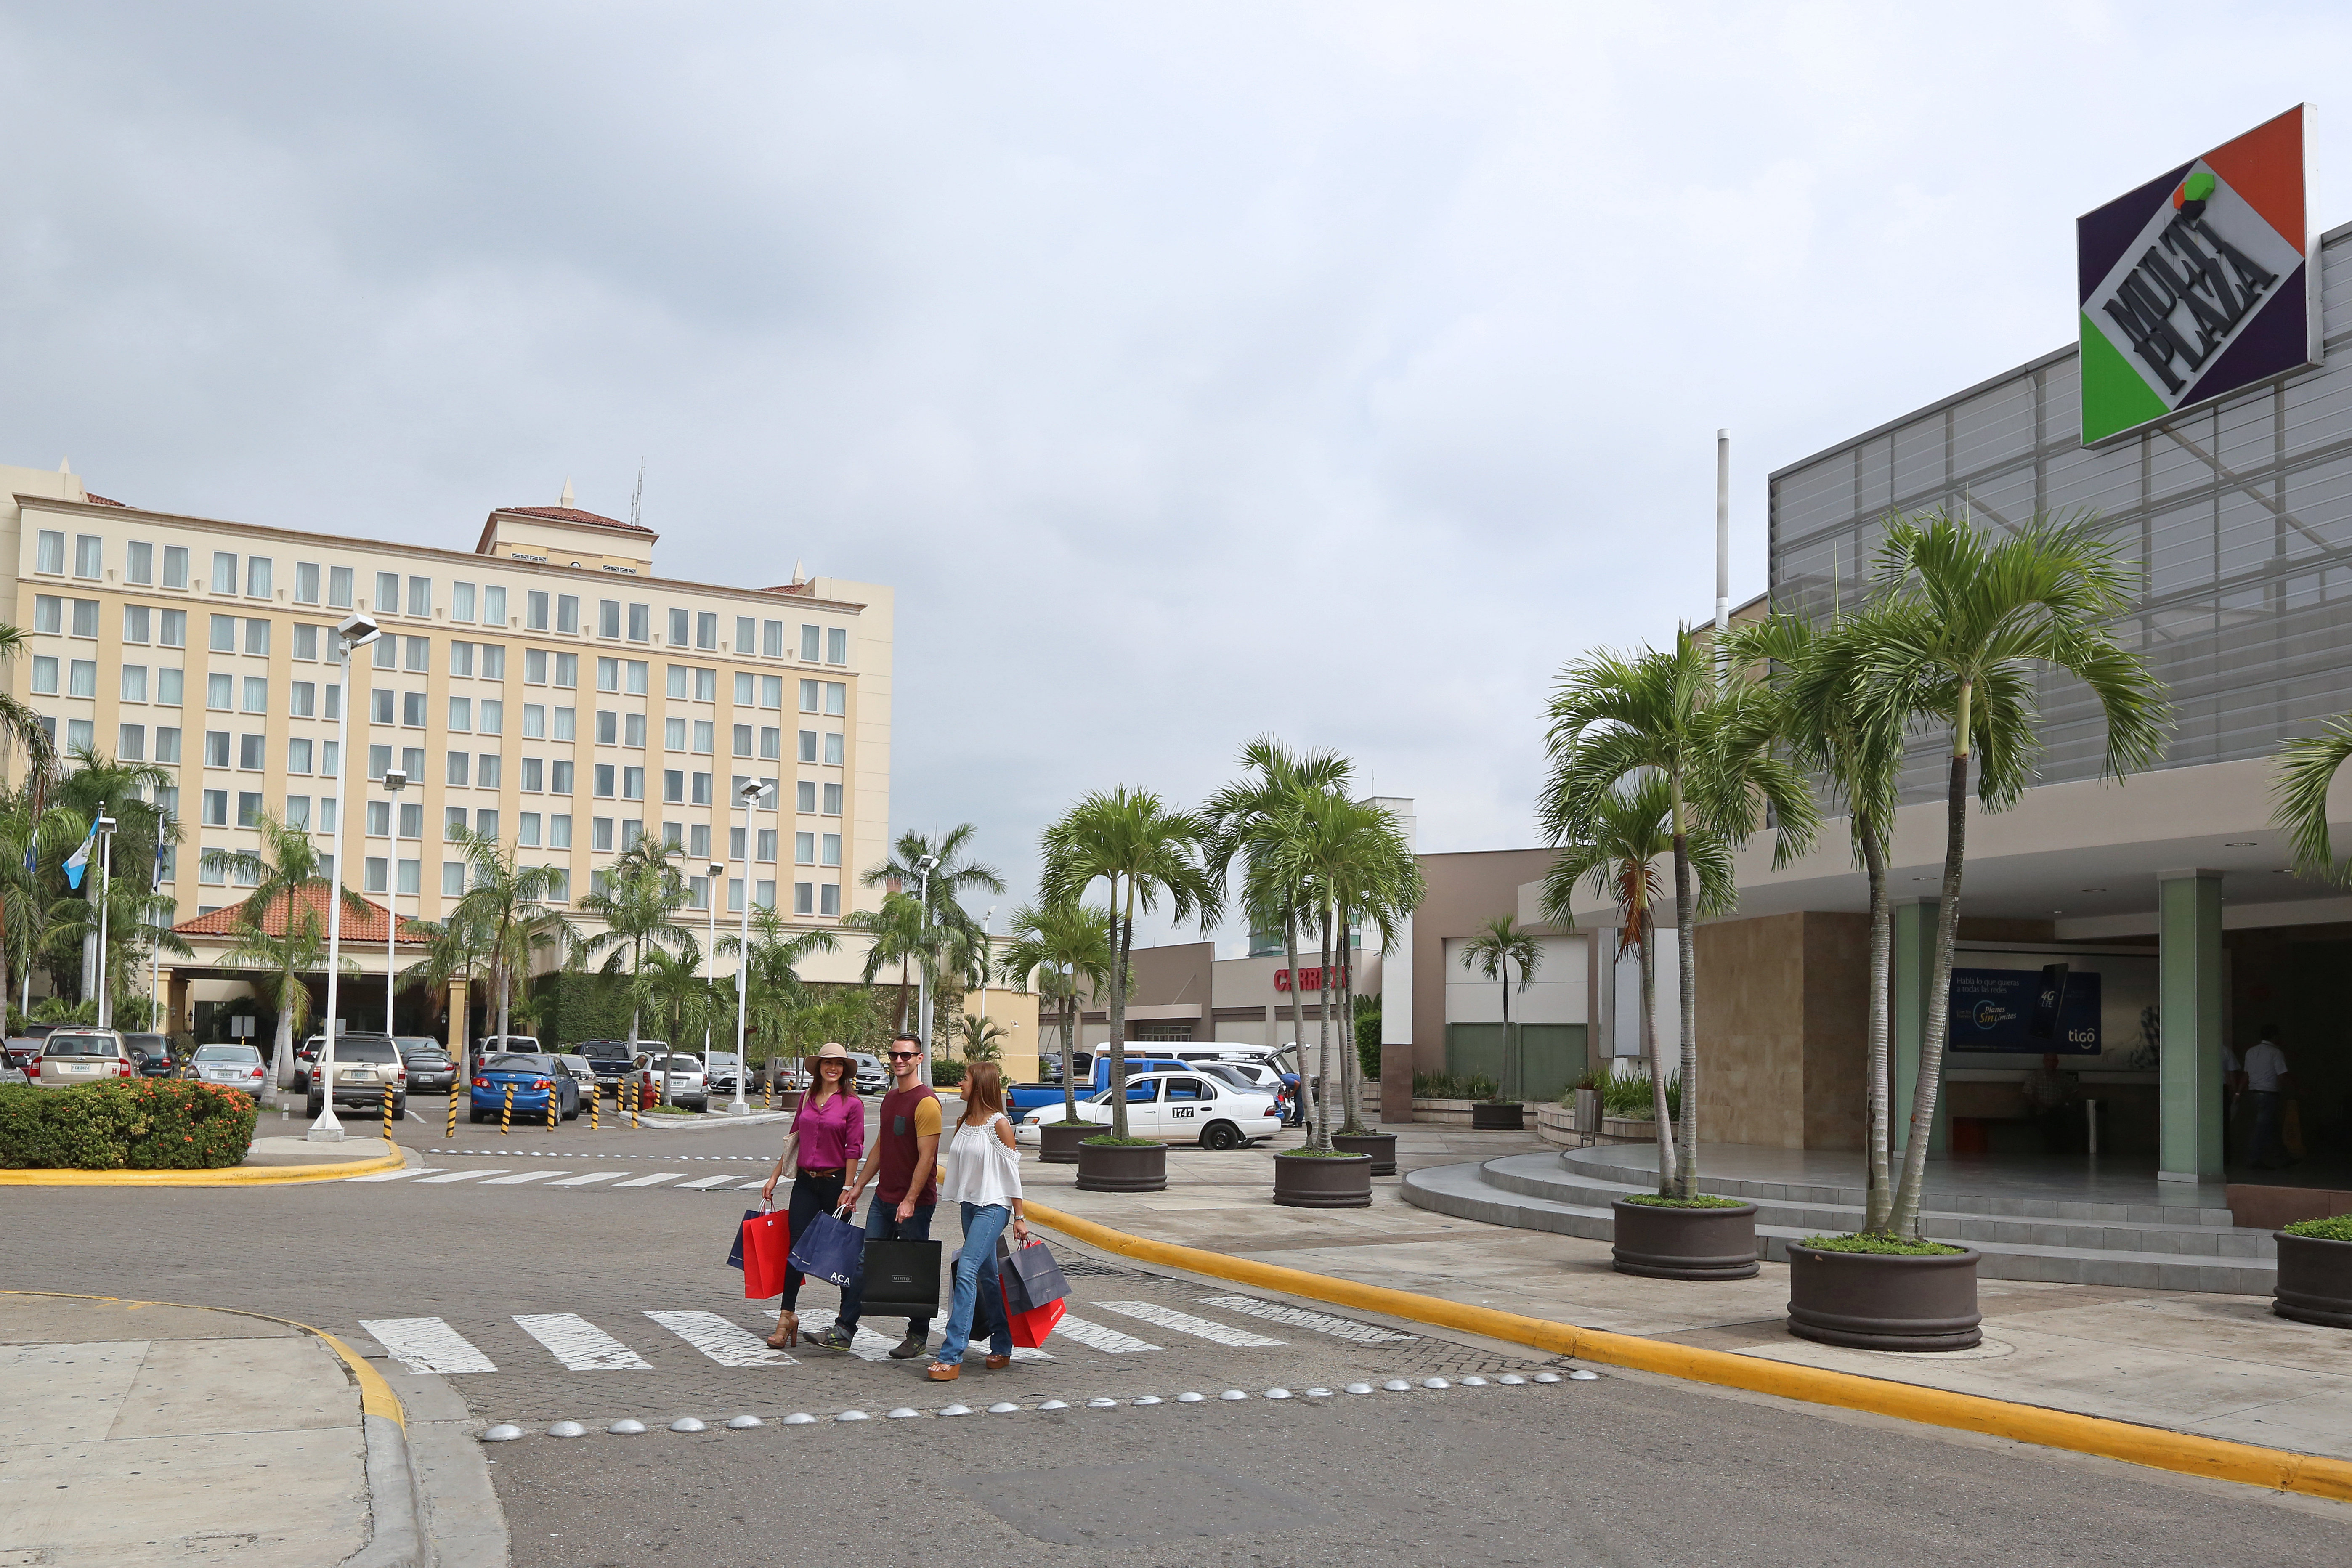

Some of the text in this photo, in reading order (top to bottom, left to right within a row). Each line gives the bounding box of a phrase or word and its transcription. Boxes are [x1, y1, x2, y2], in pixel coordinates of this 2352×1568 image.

[2134, 241, 2279, 395] PLAZA
[1984, 979, 1996, 988] que
[1997, 979, 2019, 988] quieras
[2041, 990, 2055, 1000] 4G
[1979, 1012, 1994, 1023] Sin
[2068, 1028, 2095, 1050] tigo
[1173, 1108, 1193, 1117] 1747
[830, 1272, 850, 1285] ACA
